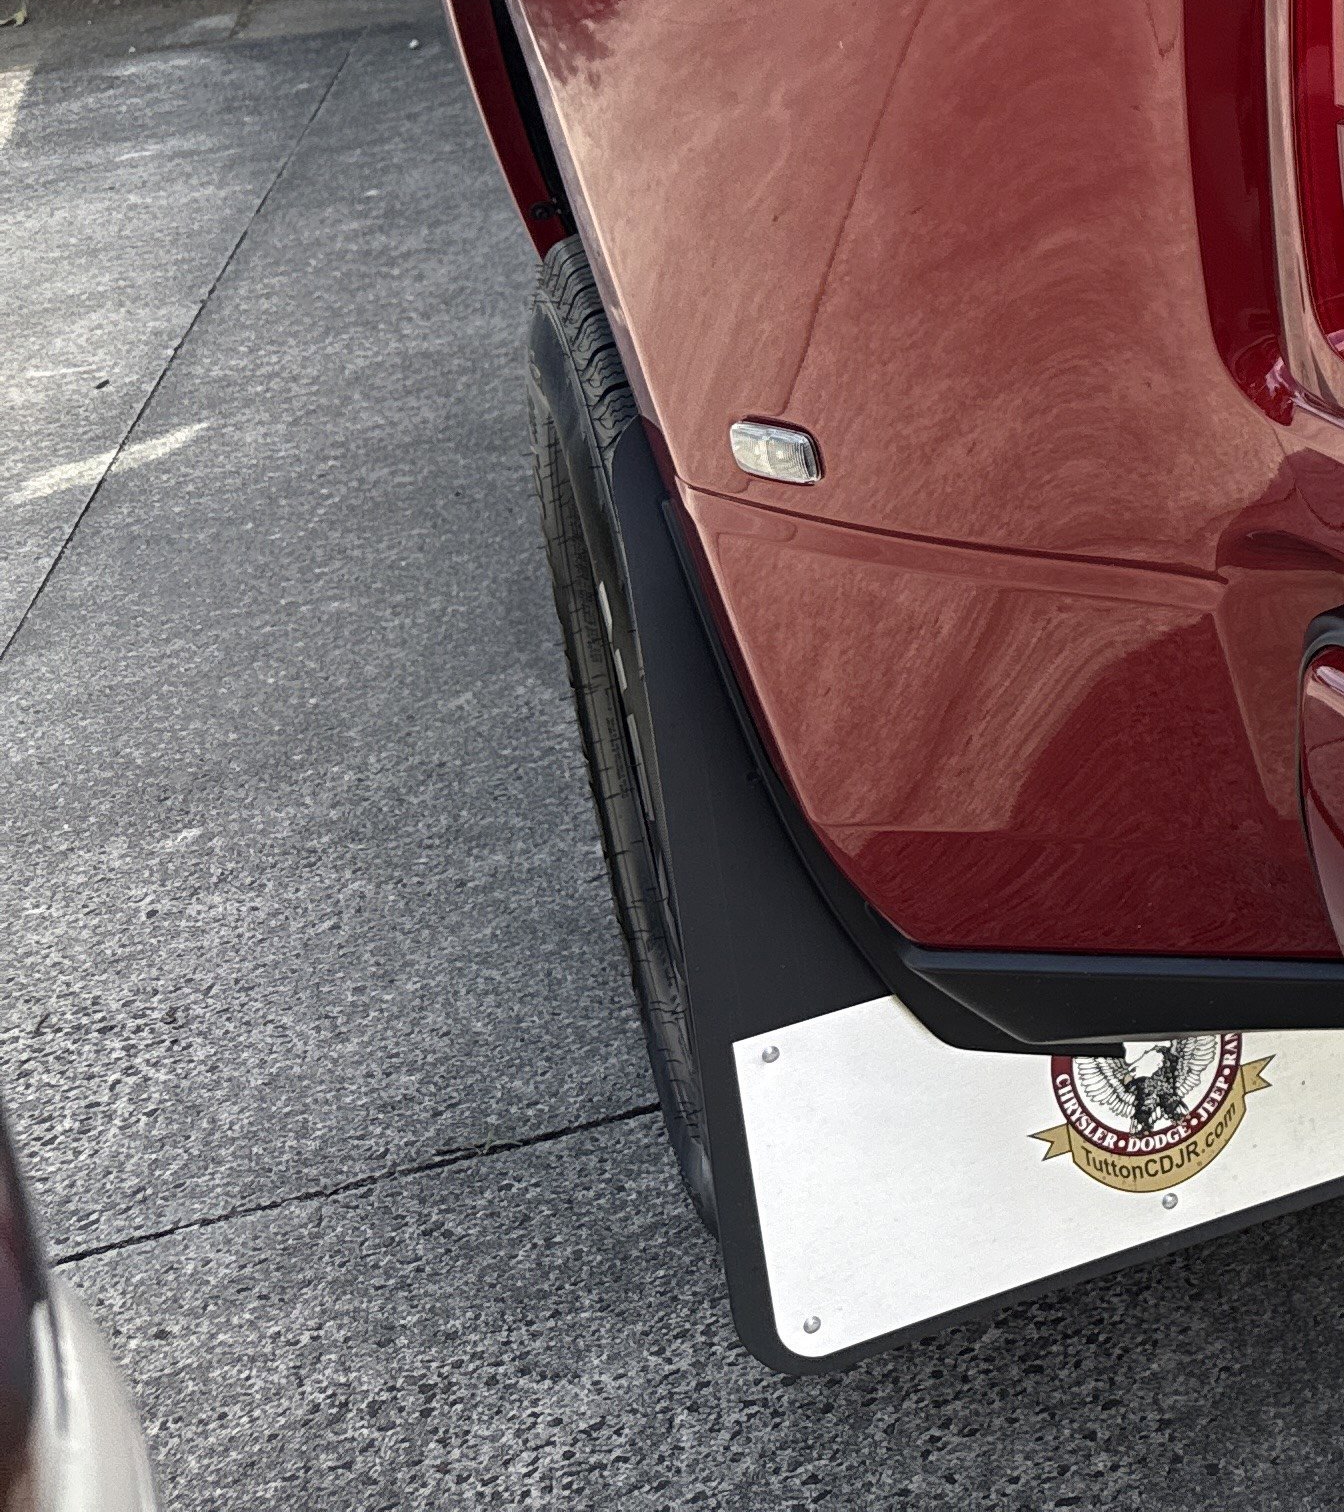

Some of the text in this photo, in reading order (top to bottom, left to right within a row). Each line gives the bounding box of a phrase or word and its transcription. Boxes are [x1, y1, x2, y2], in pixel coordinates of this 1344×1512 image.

[1055, 1073, 1116, 1149] CHRYSLER
[1126, 1120, 1192, 1152] DODGE
[1196, 1076, 1231, 1122] JEEP
[1081, 1102, 1236, 1180] TuttonCDJR.com
